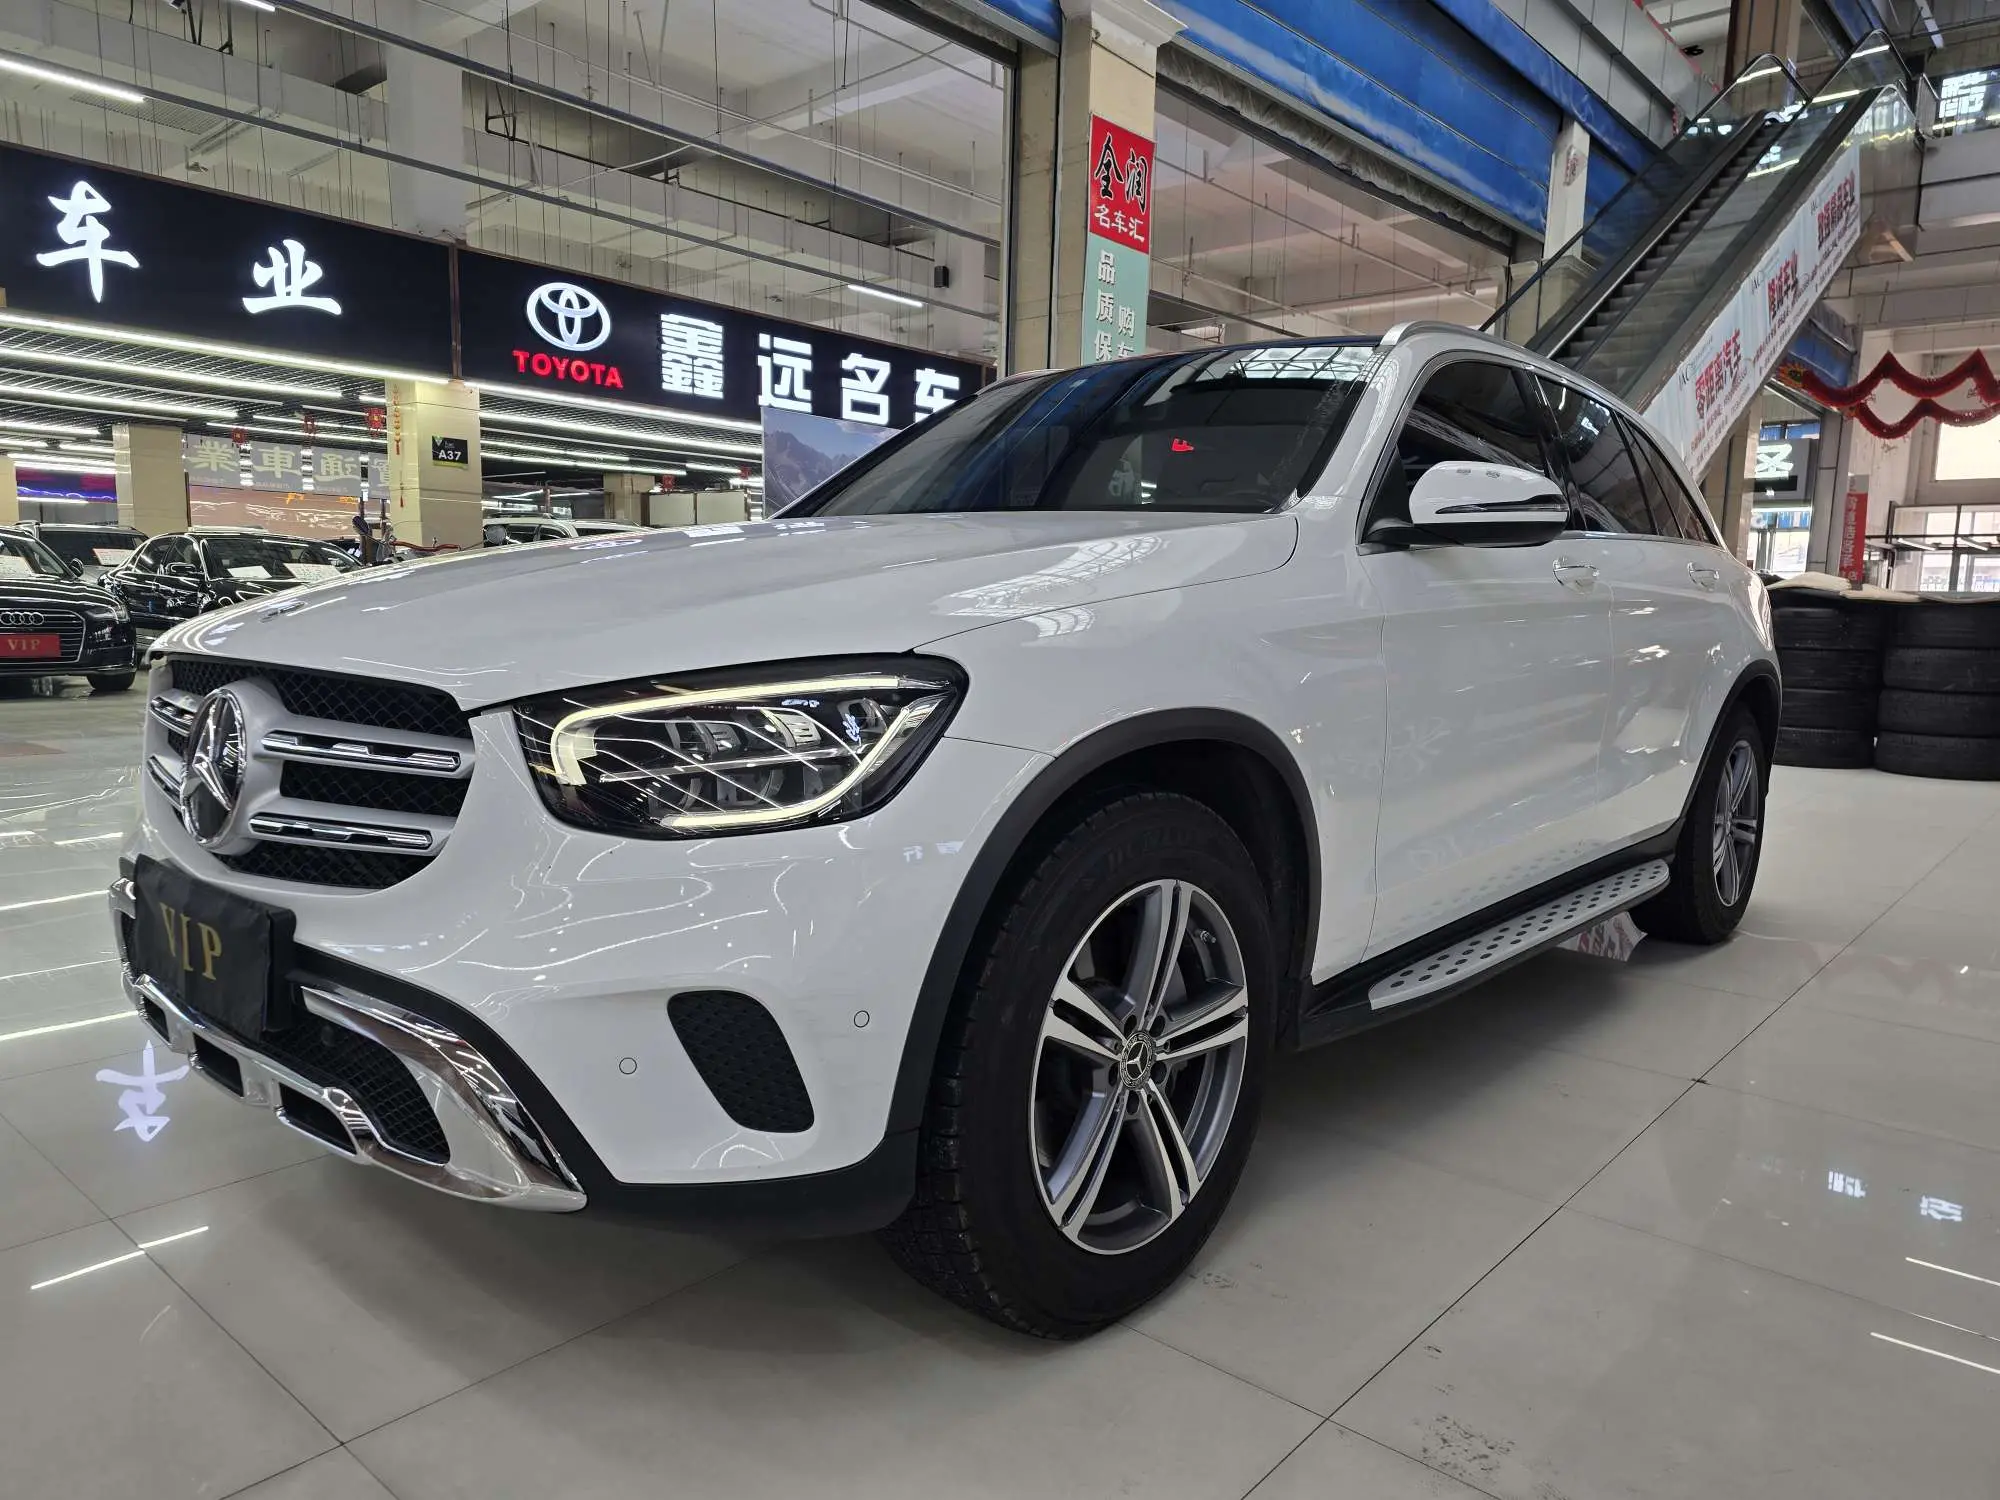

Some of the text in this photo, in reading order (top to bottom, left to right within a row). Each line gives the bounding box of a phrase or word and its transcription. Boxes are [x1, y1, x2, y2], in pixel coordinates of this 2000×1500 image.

[1094, 203, 1145, 242] 名车汇
[36, 180, 342, 315] 车业
[512, 350, 624, 389] TOYOTA
[438, 449, 462, 461] A37
[8, 638, 41, 652] VIP
[159, 902, 223, 981] VIP
